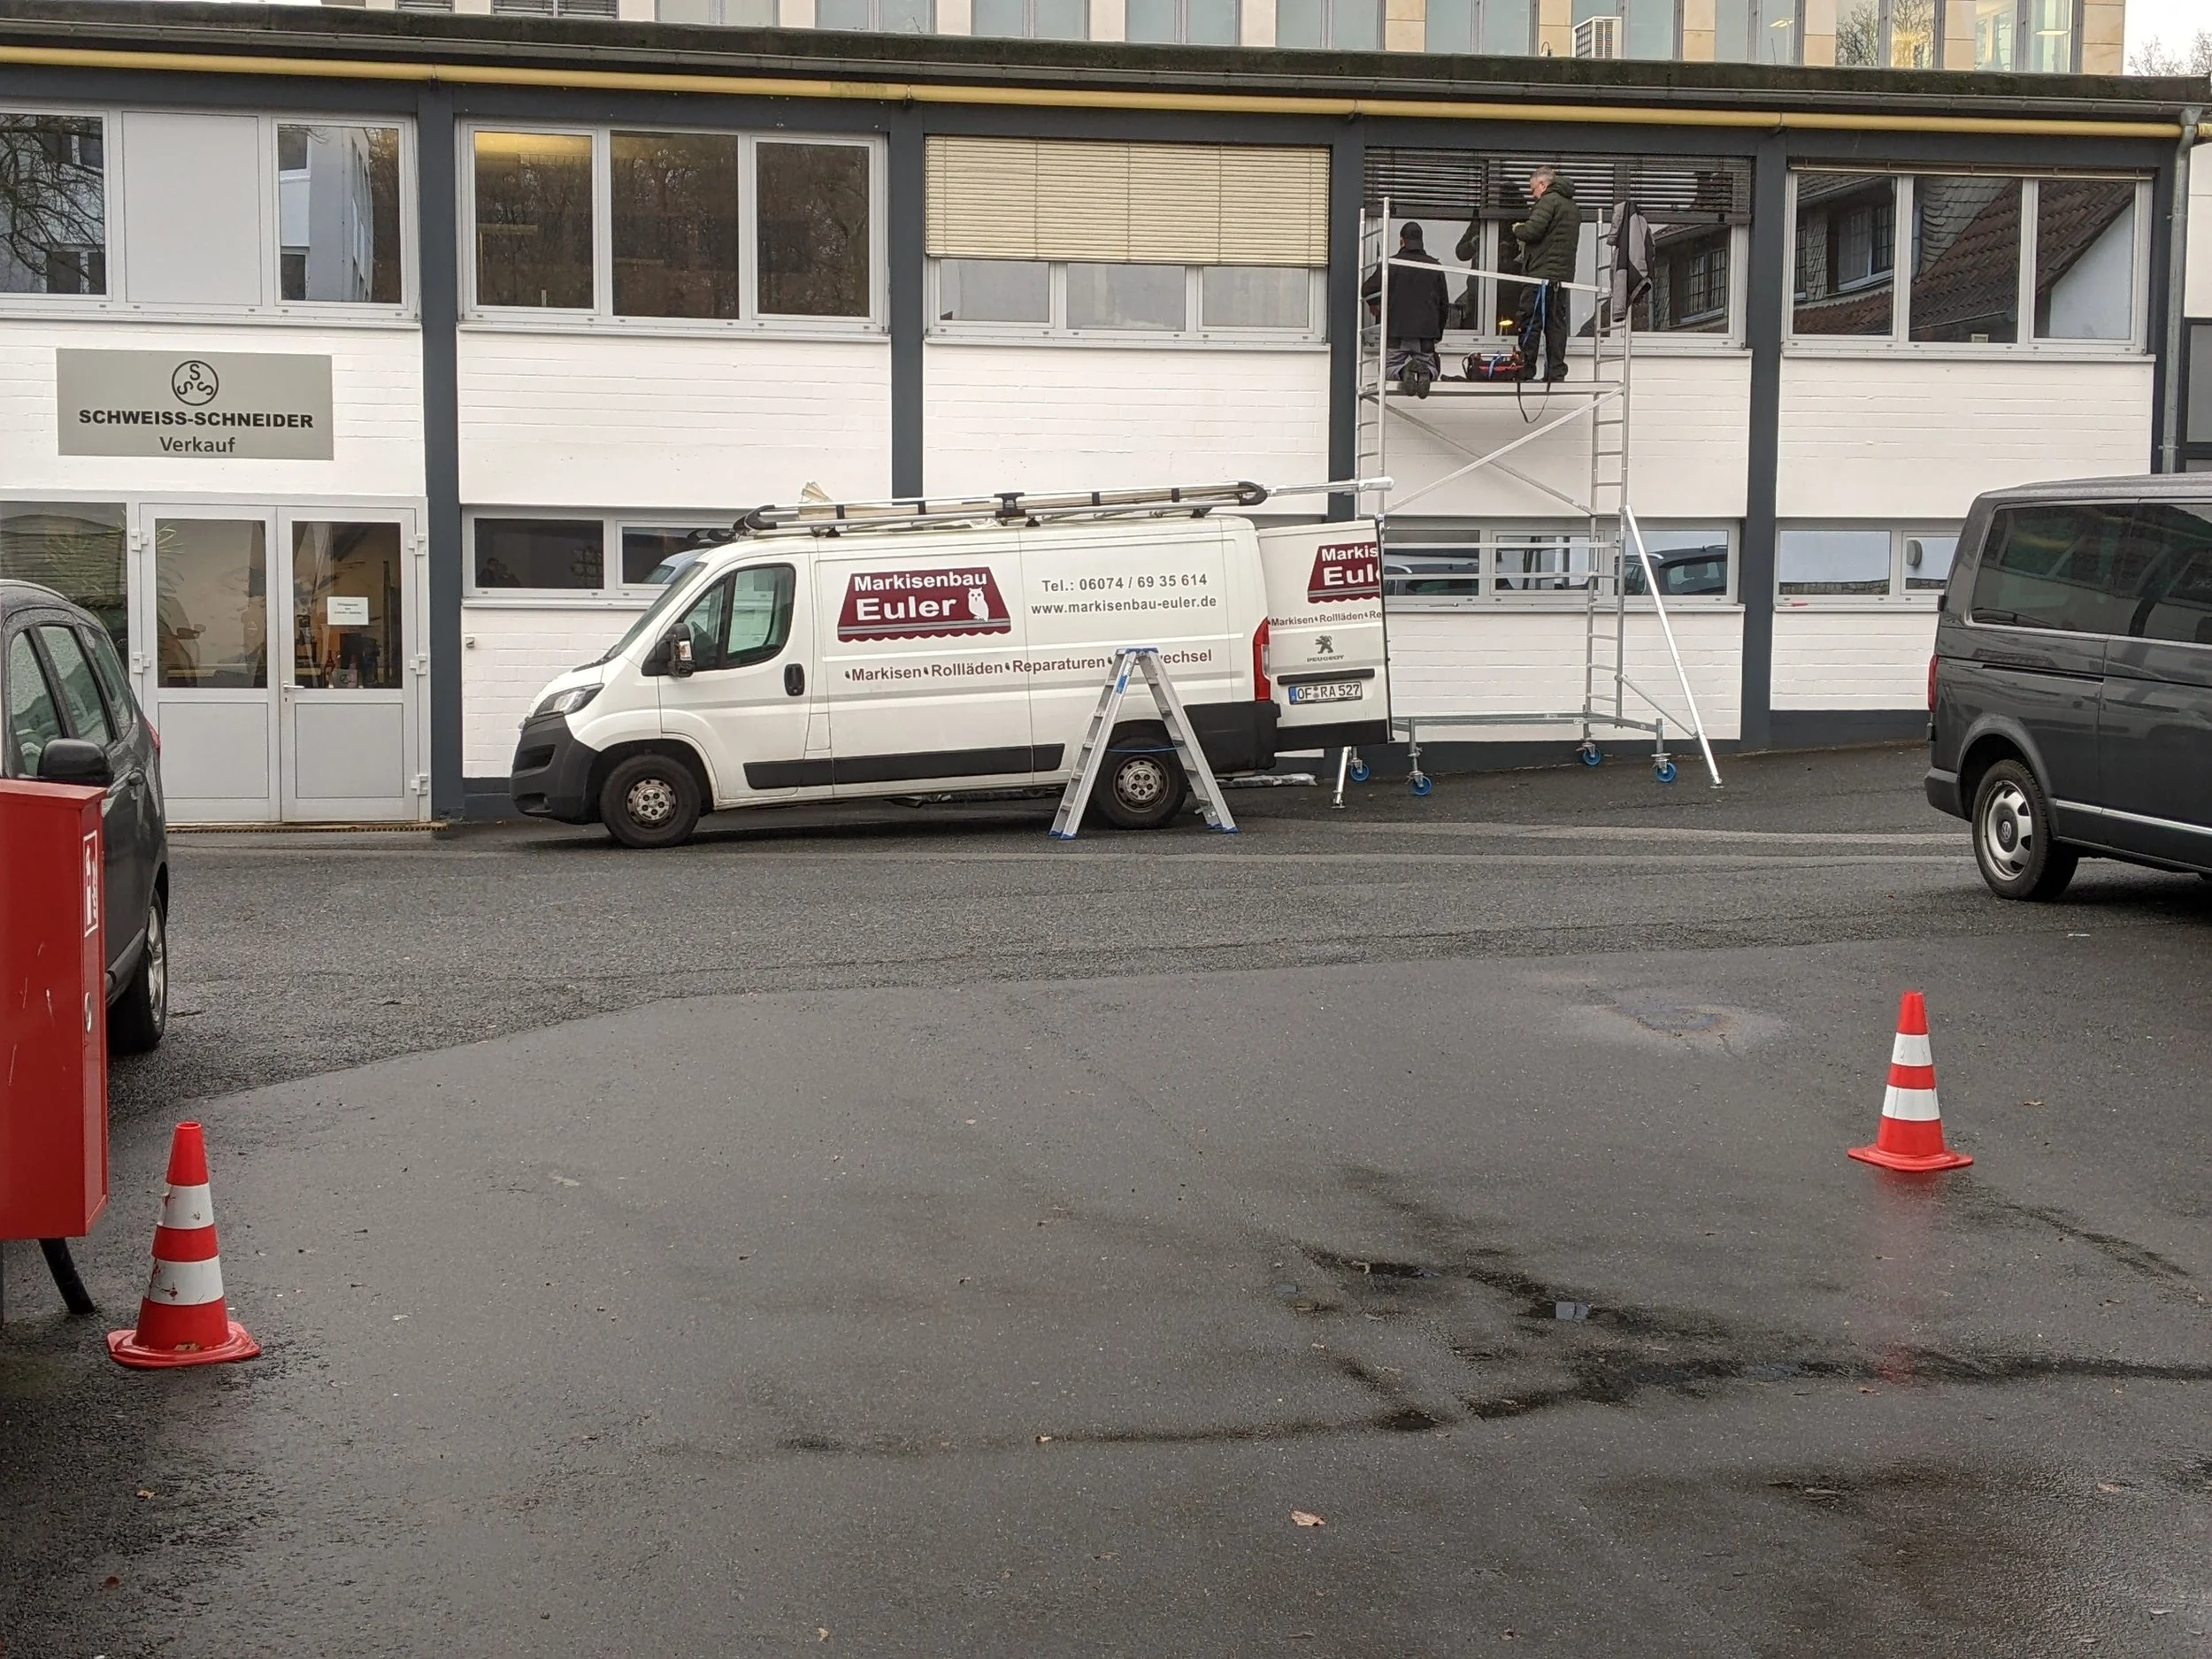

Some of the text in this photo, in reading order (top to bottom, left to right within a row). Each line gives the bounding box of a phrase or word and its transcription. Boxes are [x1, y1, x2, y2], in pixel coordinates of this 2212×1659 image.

[78, 409, 314, 428] SCHWEISS-SCHNEIDER
[159, 435, 236, 453] Verkauf
[854, 572, 987, 592] Markisenbau
[1041, 573, 1208, 592] Tel.: 06074 / 69 35 614
[1323, 564, 1379, 587] Eul
[856, 595, 956, 621] Euler
[1031, 595, 1217, 614] www.markisenbau-euler.de
[1271, 616, 1315, 626] Markisen
[1319, 612, 1363, 624] Rollläden
[852, 666, 922, 681] Markisen
[931, 662, 1003, 677] Rollläden
[1012, 657, 1105, 675] Reparaturen
[1297, 684, 1360, 700] OF RA 527
